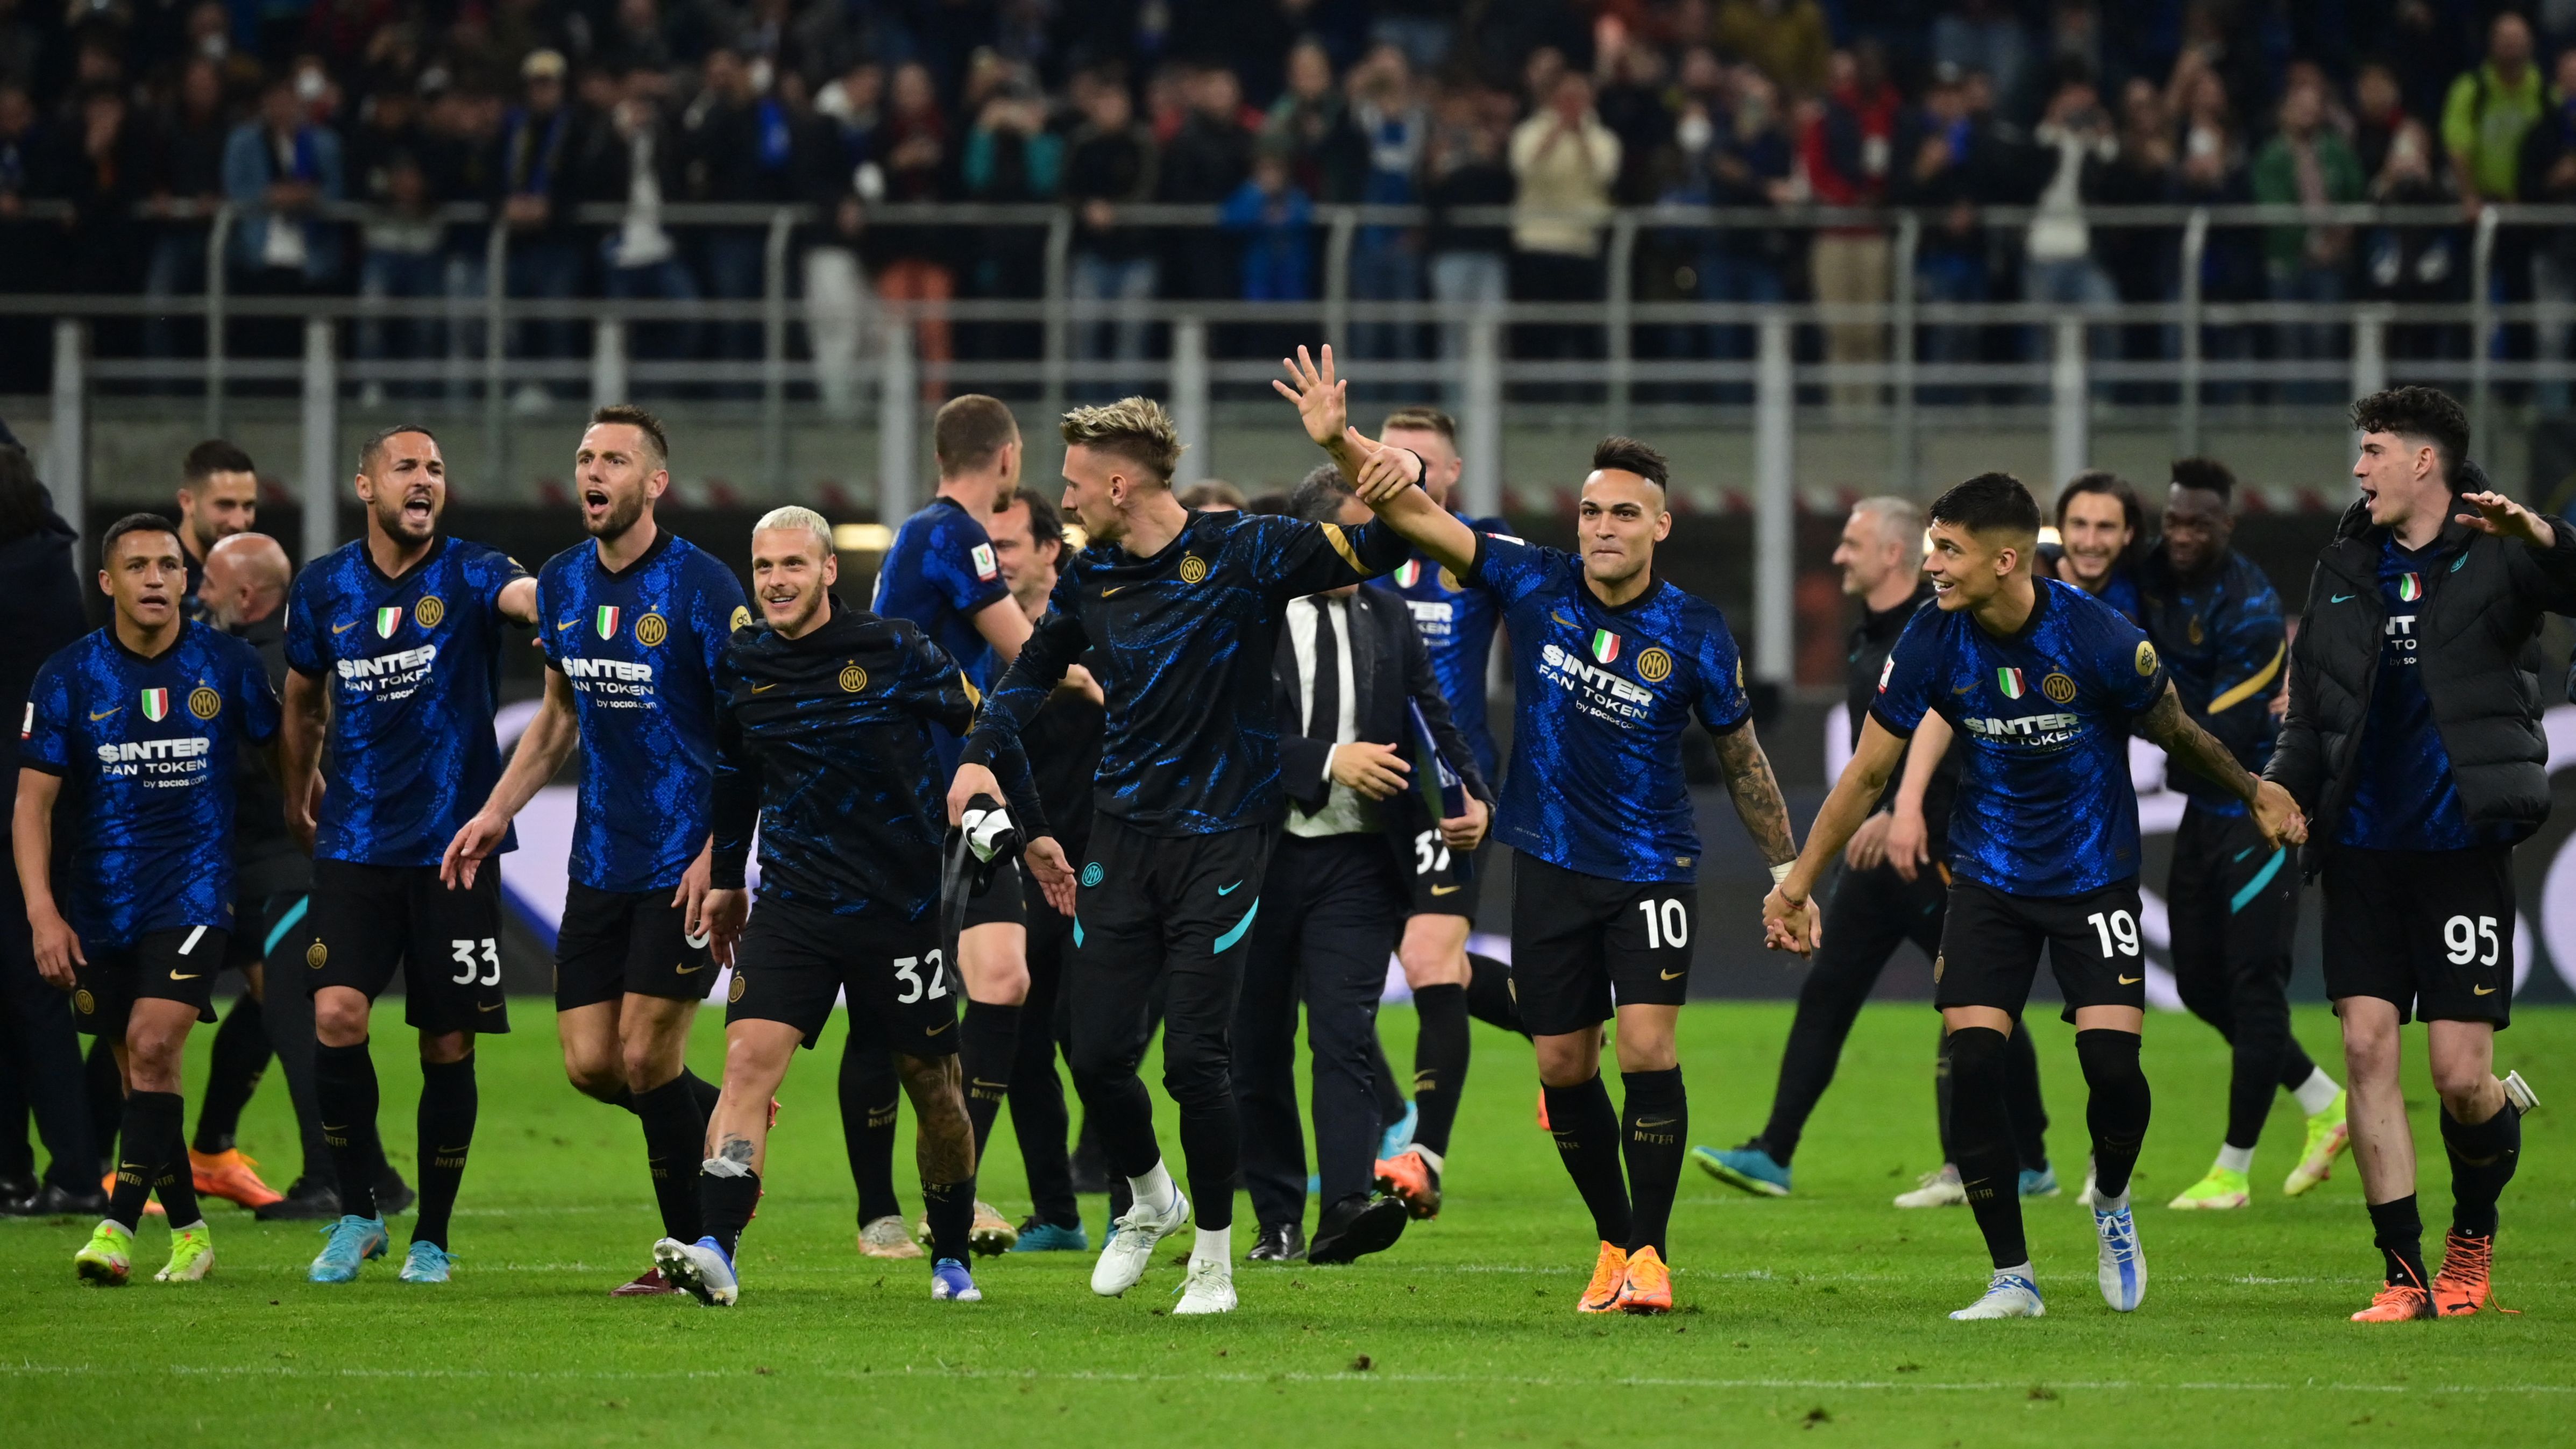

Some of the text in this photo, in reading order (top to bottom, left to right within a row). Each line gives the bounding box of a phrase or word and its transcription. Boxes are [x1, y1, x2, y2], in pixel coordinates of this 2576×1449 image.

[337, 644, 437, 680] $INTER
[562, 656, 652, 682] $INTER
[1542, 644, 1653, 707] $INTER
[377, 694, 388, 702] by
[595, 681, 654, 696] TOKEN
[1539, 664, 1648, 719] FAN TOKEN
[597, 699, 608, 708] by
[1576, 700, 1588, 713] by
[1964, 713, 2080, 735] $INTER
[2015, 727, 2082, 746] TOKEN
[97, 737, 210, 764] $INTER
[103, 758, 207, 775] FAN TOKEN
[144, 780, 156, 789] by
[1640, 898, 1687, 949] 10
[2088, 910, 2139, 958] 19
[2444, 915, 2499, 967] 95
[452, 937, 500, 986] 33
[893, 948, 947, 1004] 32
[1634, 1130, 1673, 1145] INTER
[435, 1157, 465, 1169] INTER
[118, 1171, 142, 1186] INTER
